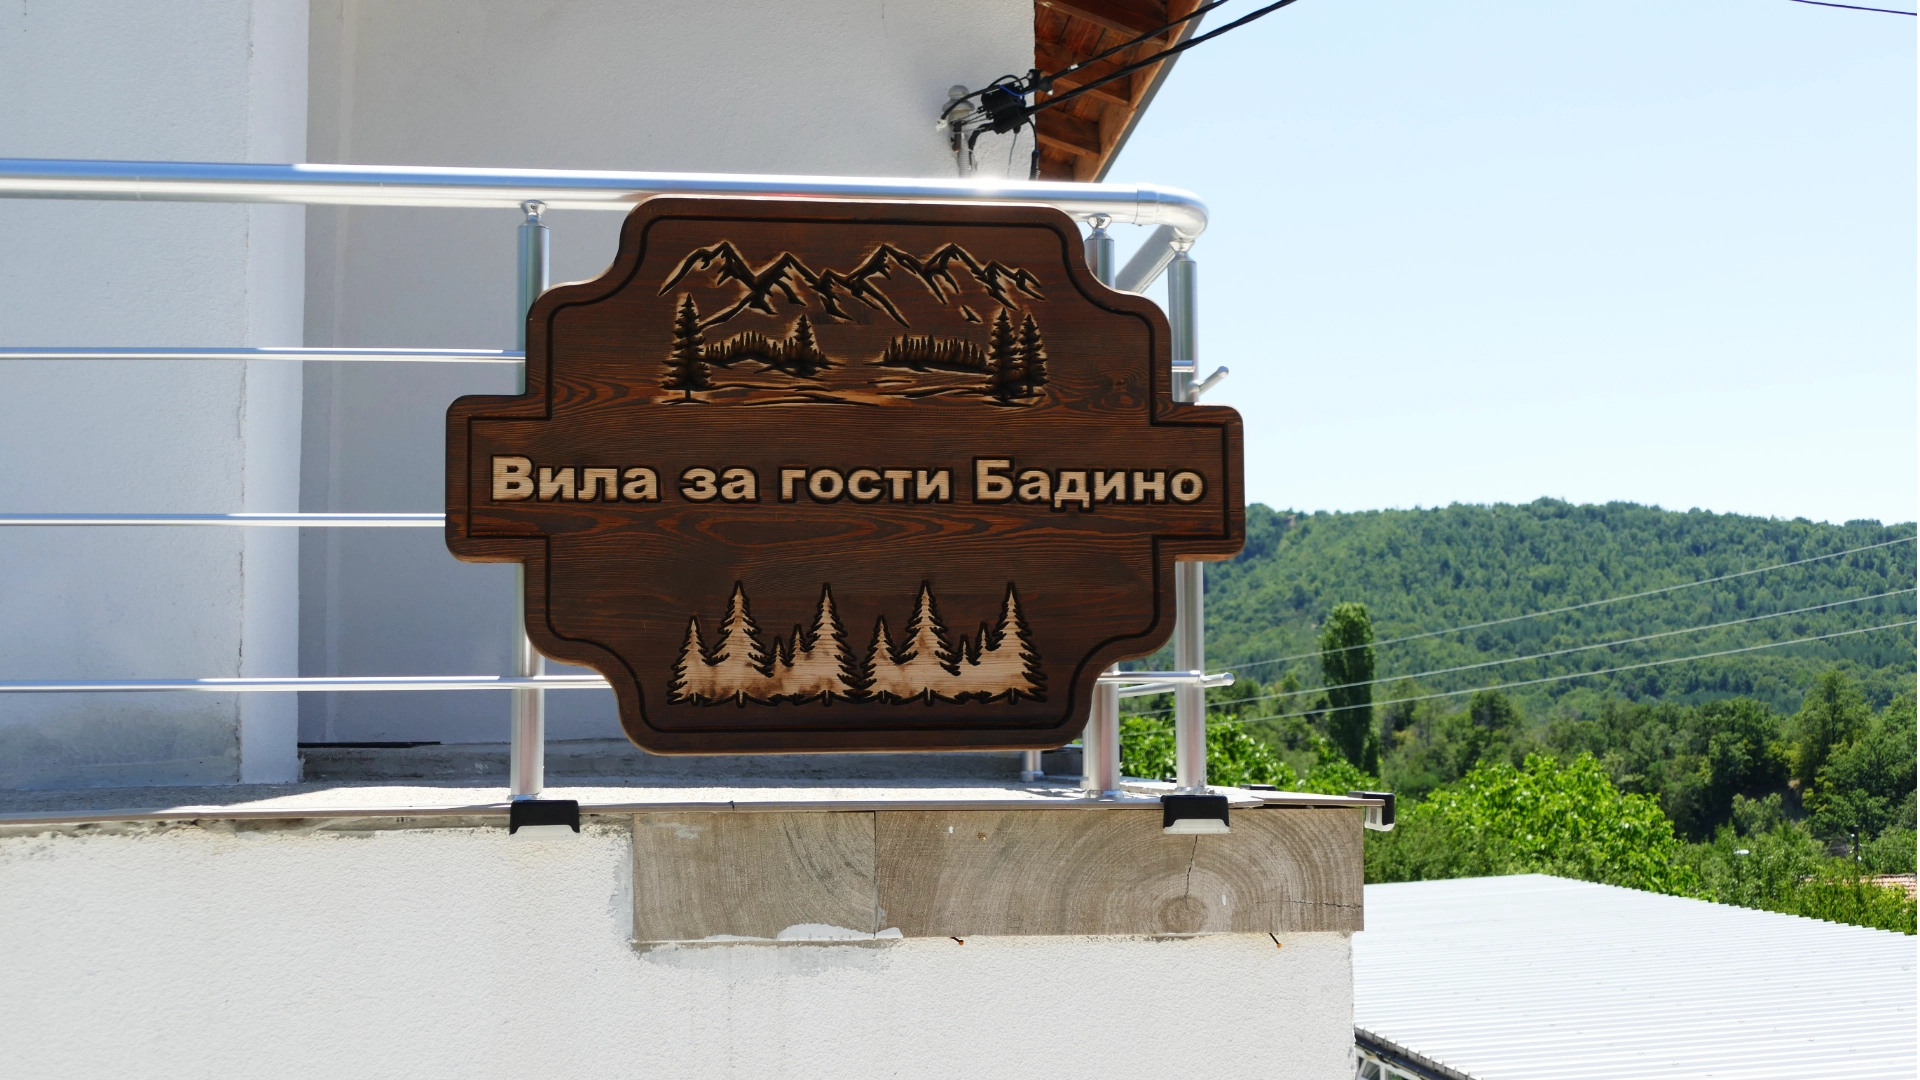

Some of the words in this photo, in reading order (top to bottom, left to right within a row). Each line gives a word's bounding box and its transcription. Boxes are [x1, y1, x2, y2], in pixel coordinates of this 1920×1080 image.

[491, 456, 659, 501] Вила
[680, 467, 757, 502] за
[780, 468, 950, 501] гости
[976, 459, 1204, 508] Бадино
